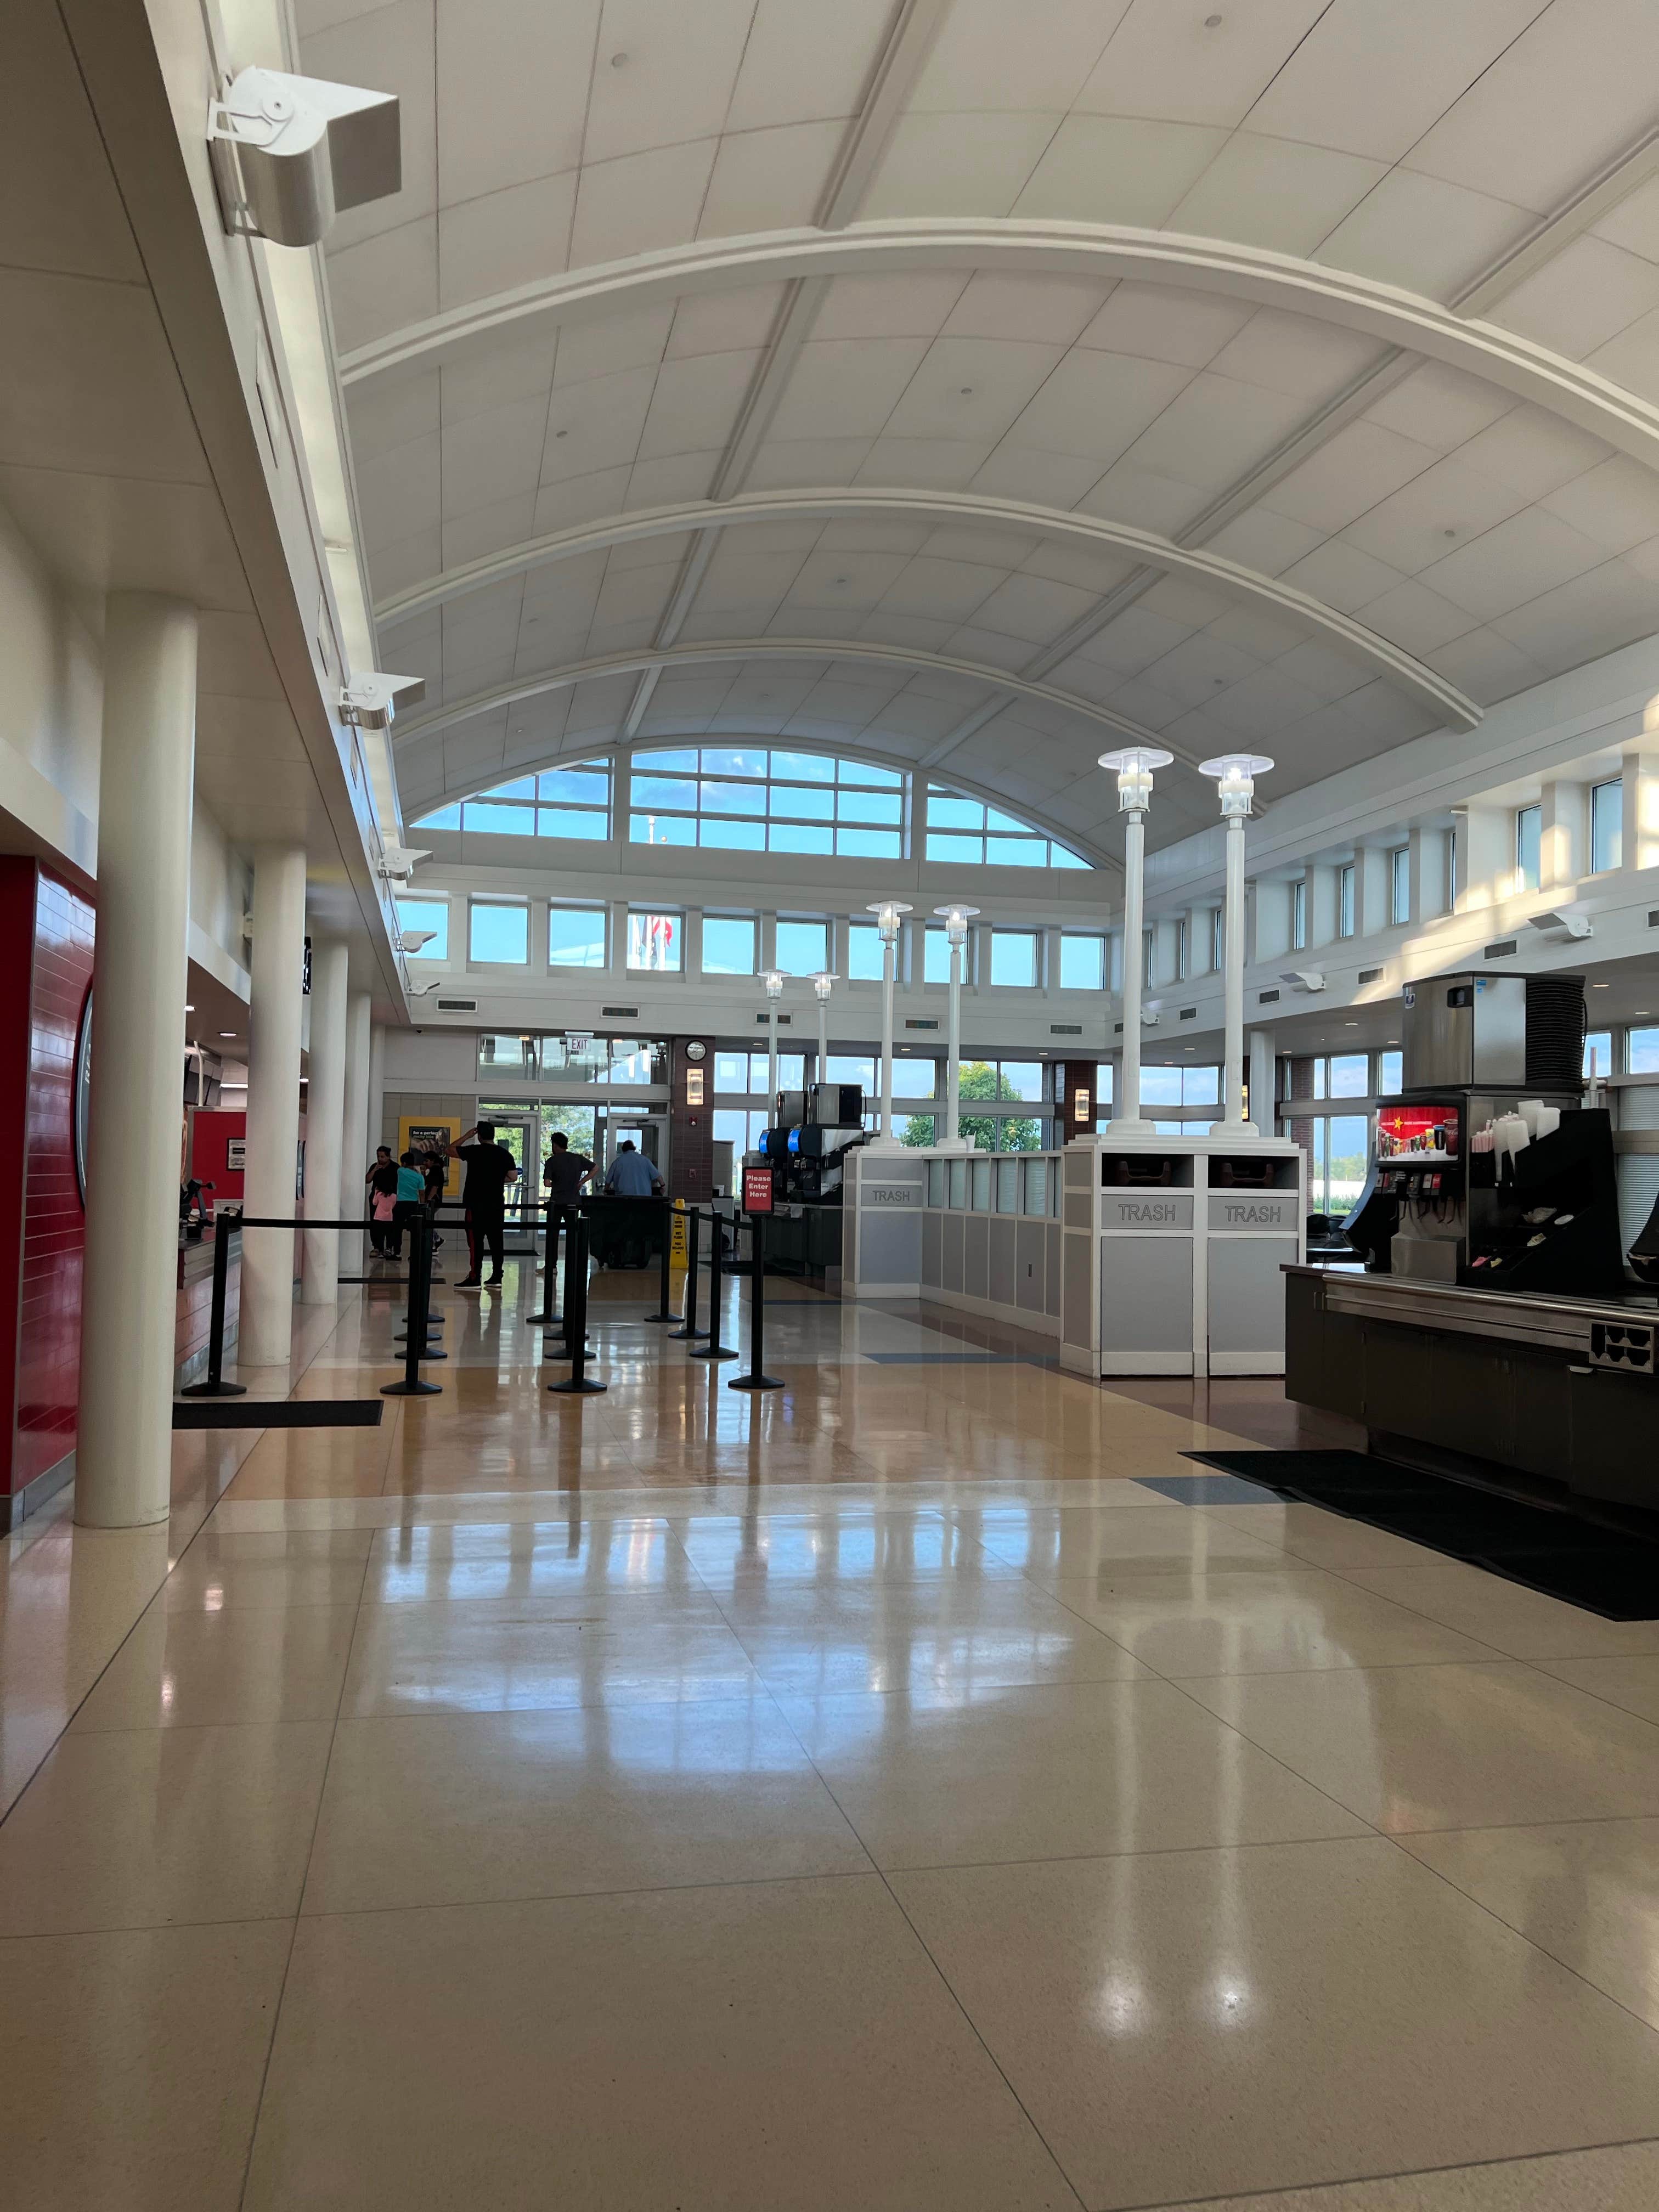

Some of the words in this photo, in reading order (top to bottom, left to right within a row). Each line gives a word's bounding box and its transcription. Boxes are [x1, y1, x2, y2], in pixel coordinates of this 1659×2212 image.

[572, 1039, 588, 1049] EXIT
[872, 1190, 910, 1201] TRASH
[1118, 1204, 1176, 1221] TRASH
[1224, 1205, 1282, 1223] TRASH
